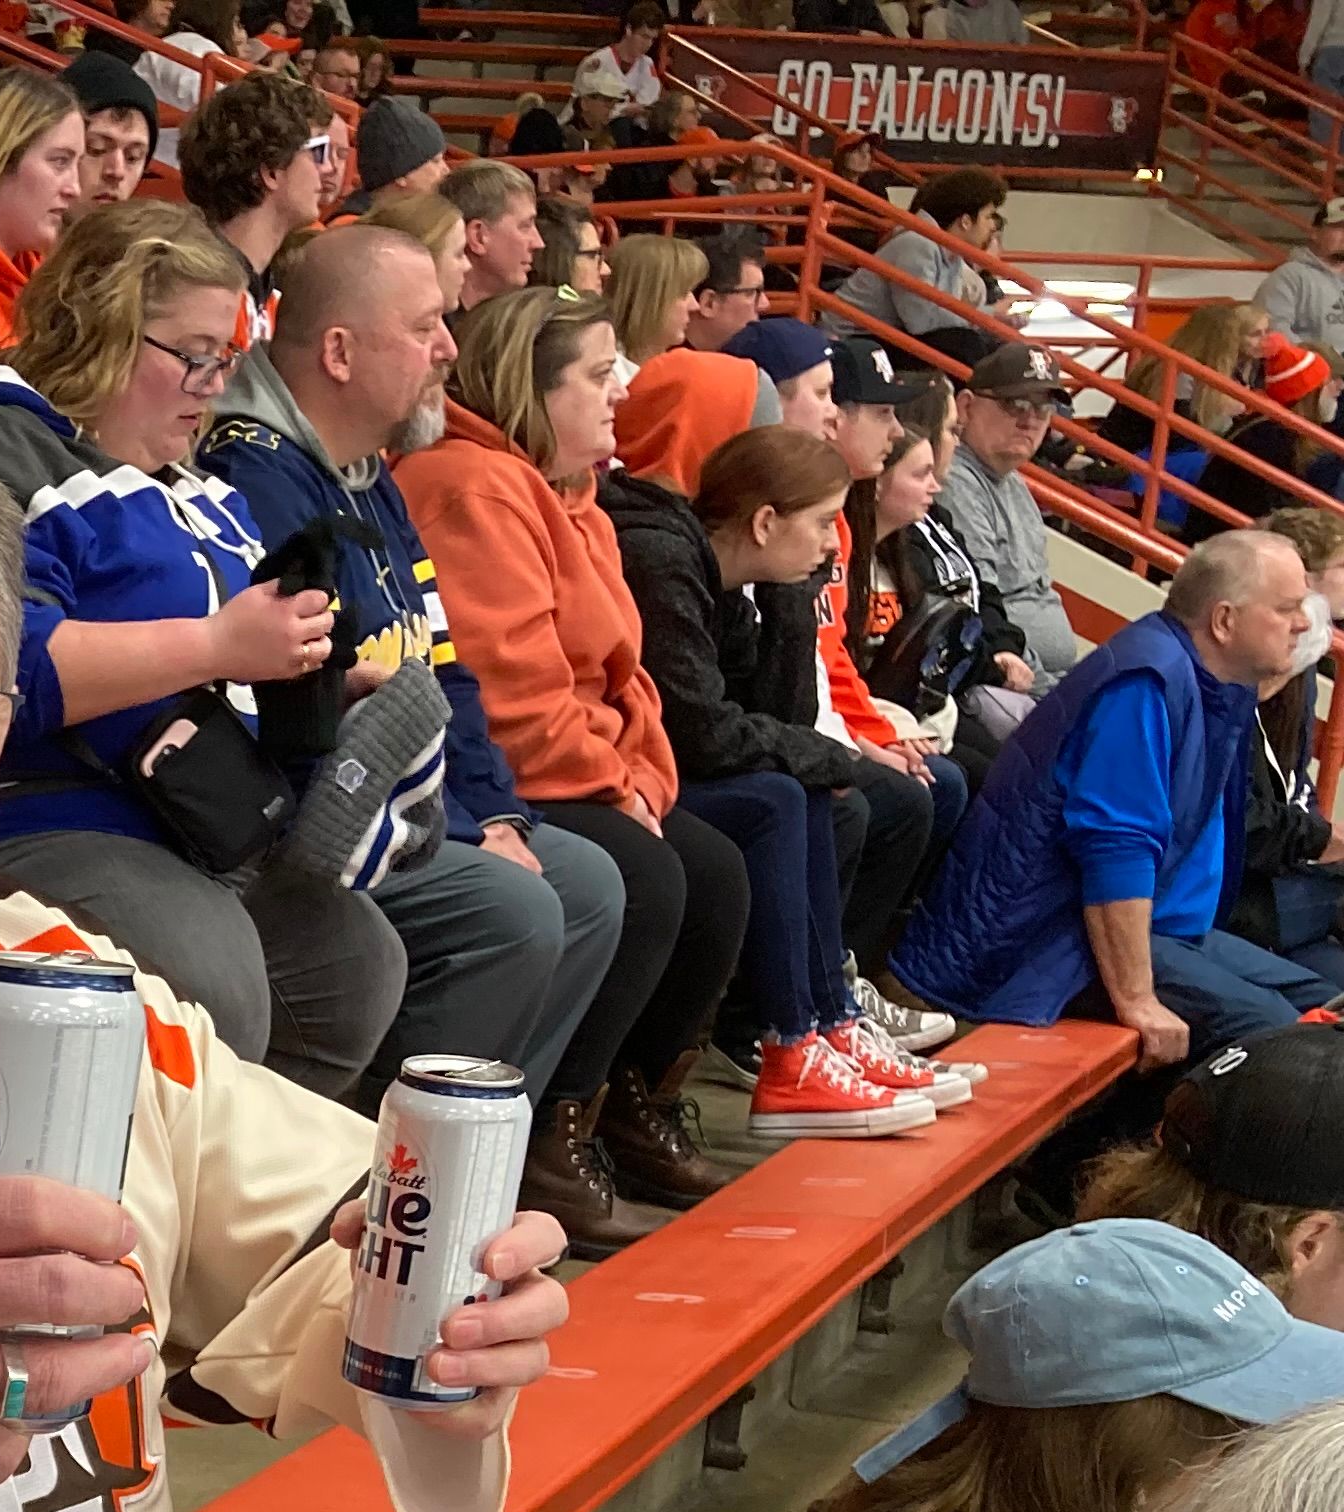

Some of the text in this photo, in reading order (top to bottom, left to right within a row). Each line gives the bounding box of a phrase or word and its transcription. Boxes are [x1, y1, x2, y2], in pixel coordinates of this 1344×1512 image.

[773, 60, 833, 138] GO
[848, 61, 1066, 149] FALCONS!
[358, 1231, 425, 1286] HT
